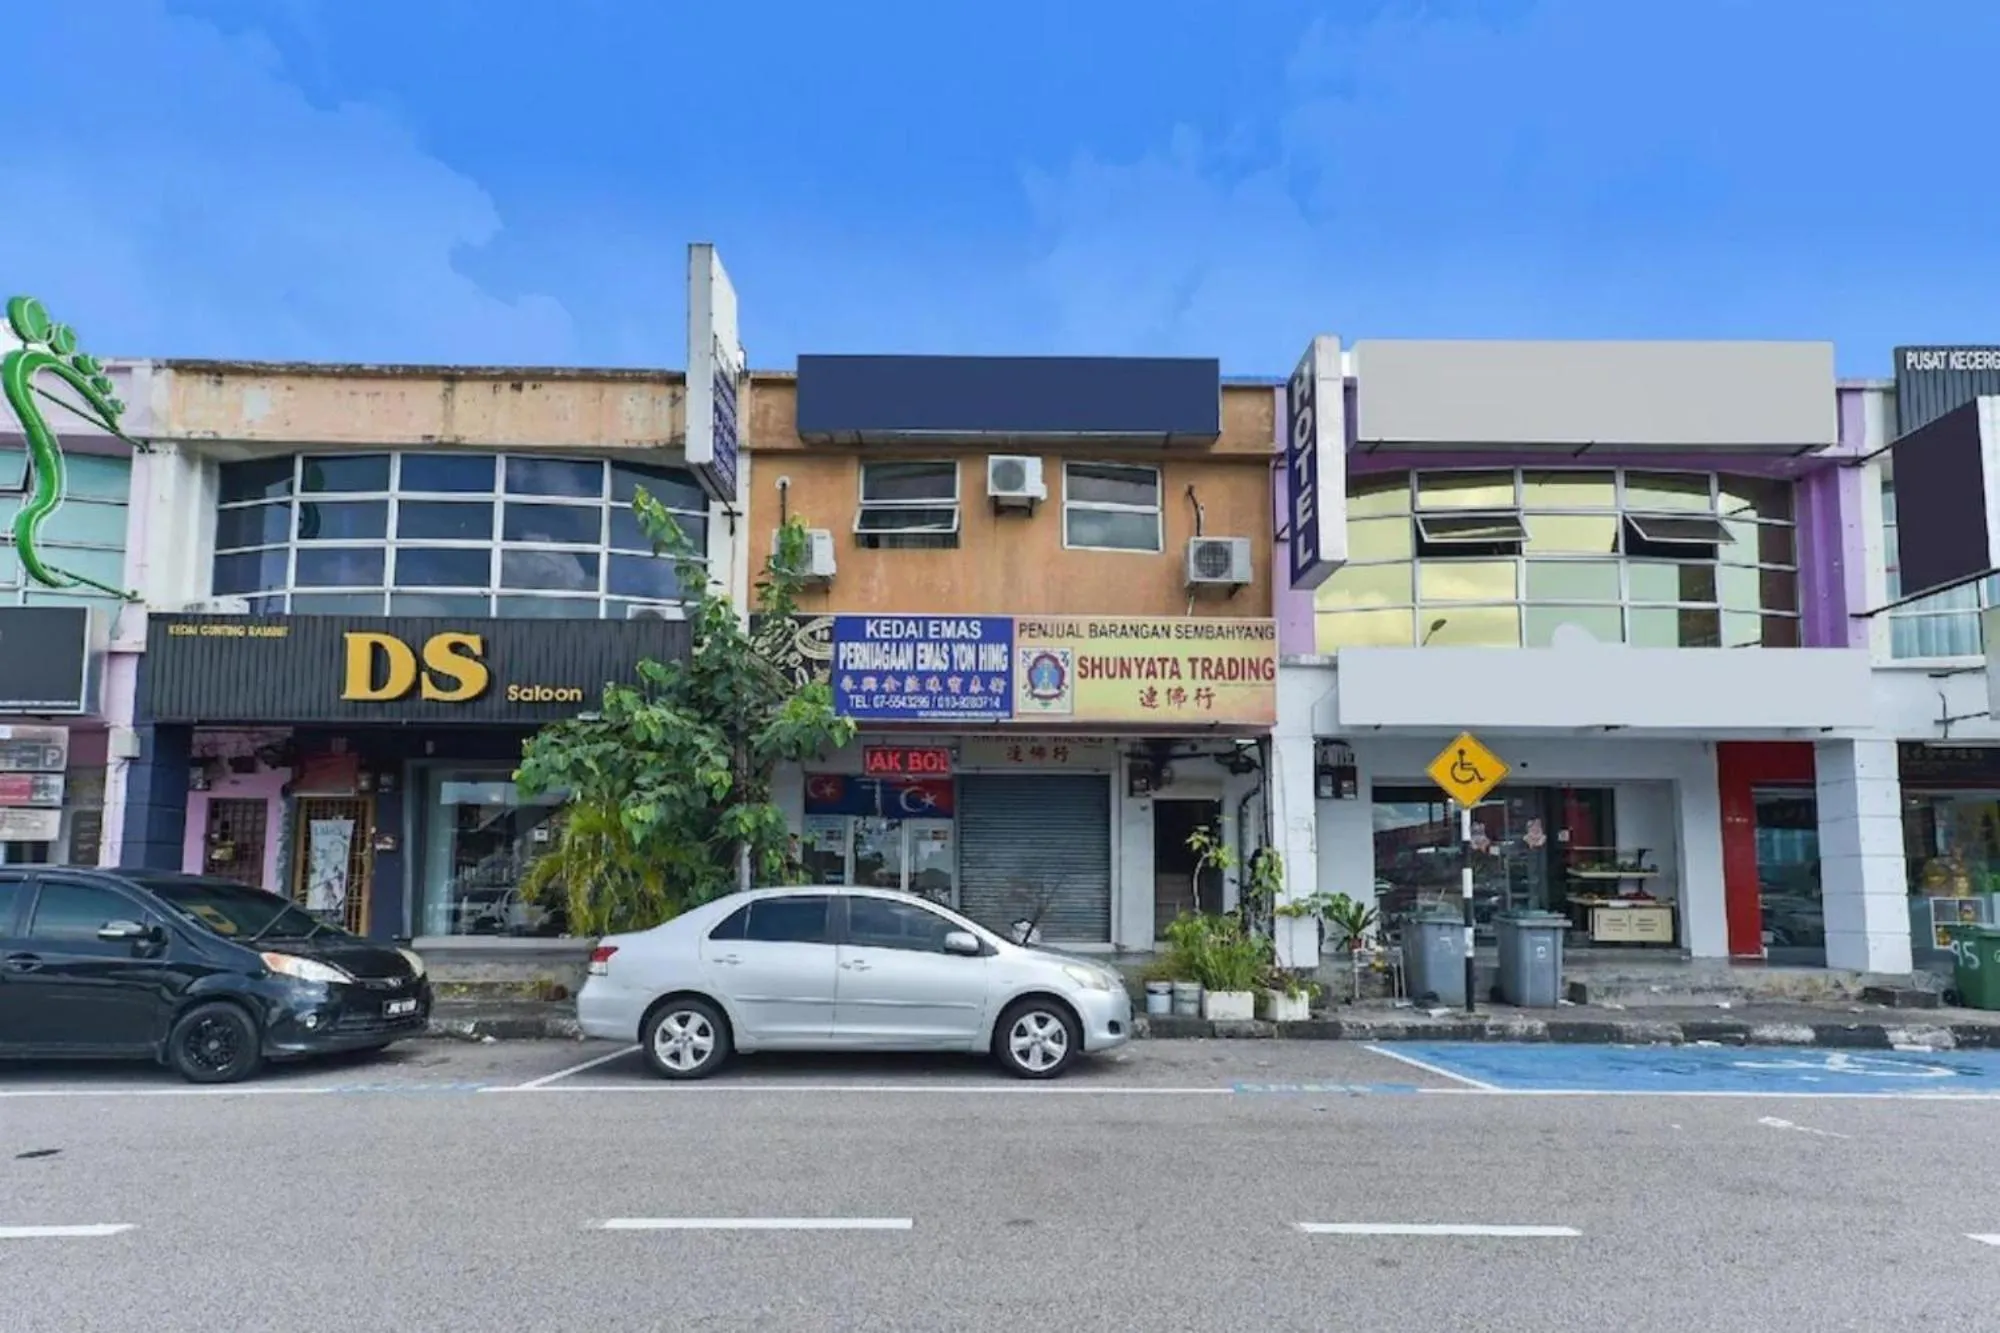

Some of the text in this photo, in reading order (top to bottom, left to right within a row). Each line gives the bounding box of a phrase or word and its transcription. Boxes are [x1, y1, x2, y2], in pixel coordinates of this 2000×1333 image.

[1906, 351, 1947, 370] PUSAT
[1294, 361, 1316, 569] HOTEL
[865, 619, 982, 639] KEDAI EMAS
[1018, 622, 1275, 640] PENJUAL BARANGAN SEMBAHYANG
[340, 631, 489, 702] DS
[916, 643, 950, 671] EMAS
[1077, 656, 1275, 681] SHUNYATA TRADING
[507, 684, 582, 702] Saloon
